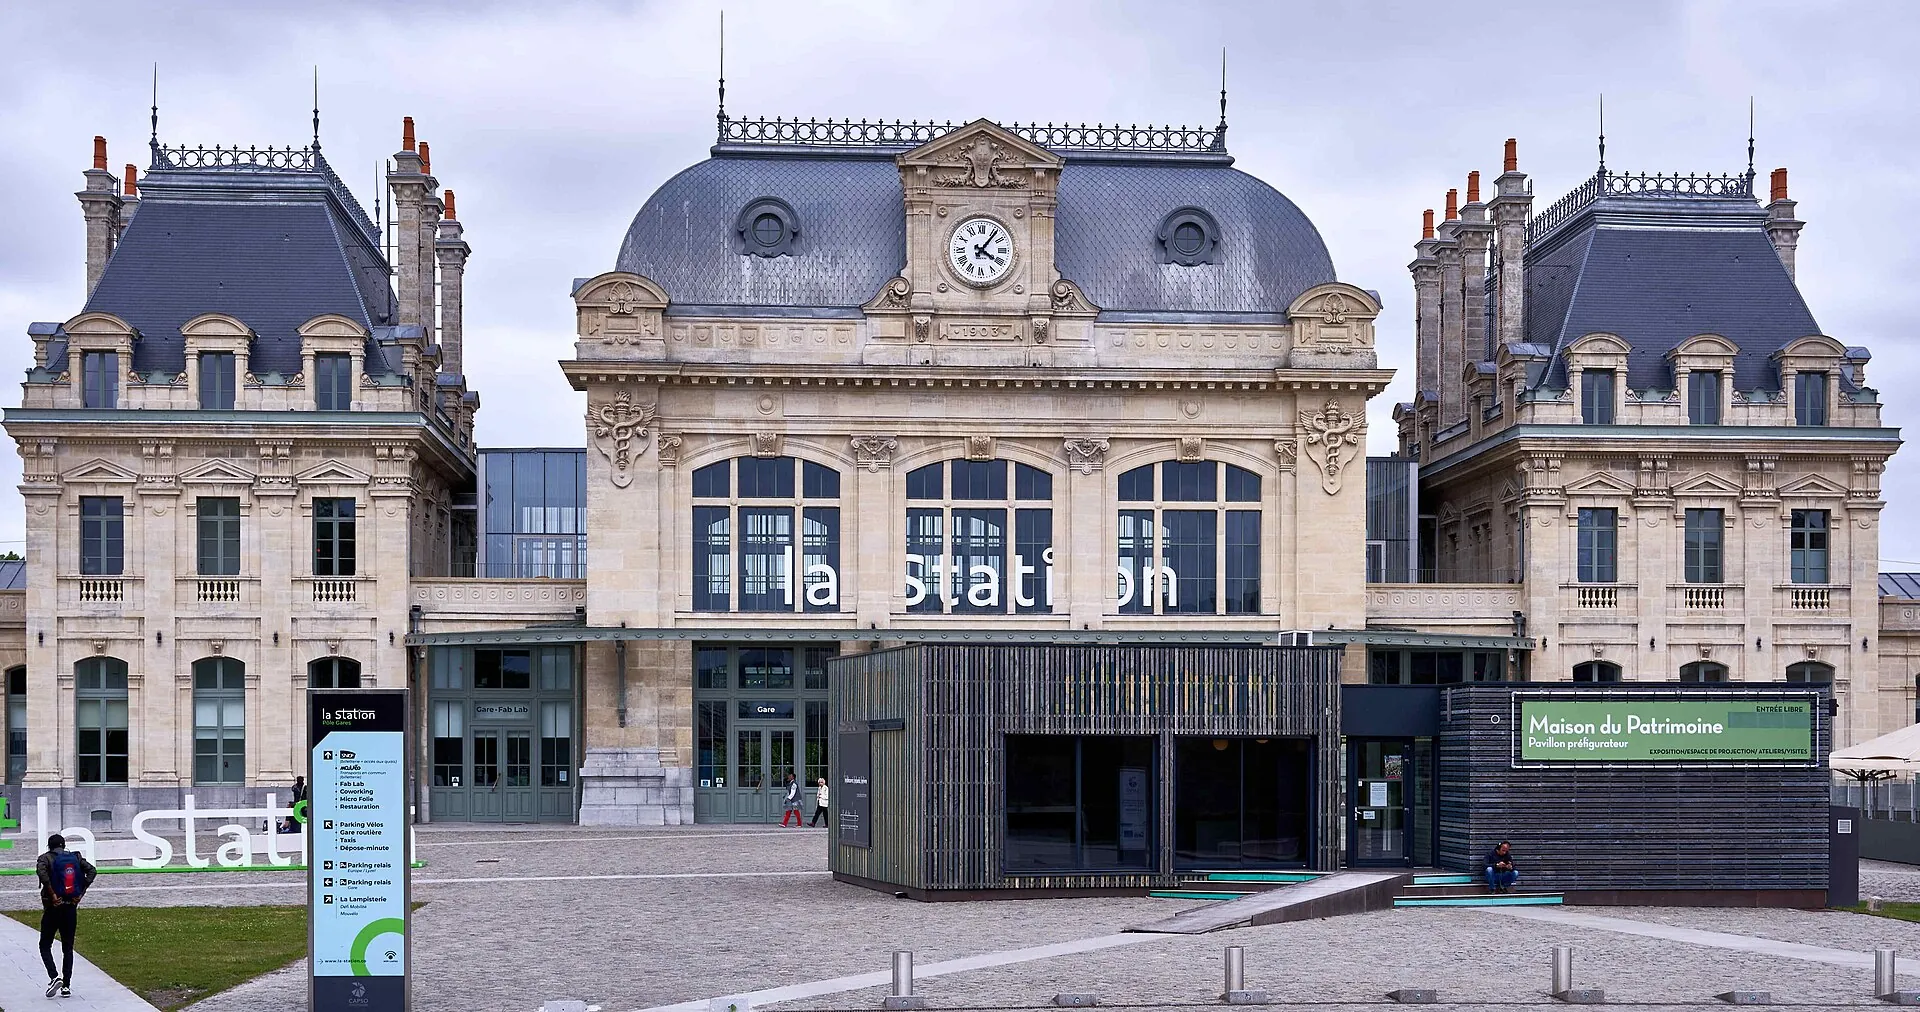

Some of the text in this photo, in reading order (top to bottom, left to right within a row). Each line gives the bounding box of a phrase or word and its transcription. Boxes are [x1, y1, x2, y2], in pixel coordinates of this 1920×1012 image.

[962, 327, 999, 337] 1903
[785, 546, 838, 605] la
[322, 708, 331, 719] la
[1756, 704, 1803, 713] ENTRÉE LIBRE
[1529, 714, 1723, 735] Maison du Patrimoine
[1528, 737, 1629, 750] Pavillon préfigurateur
